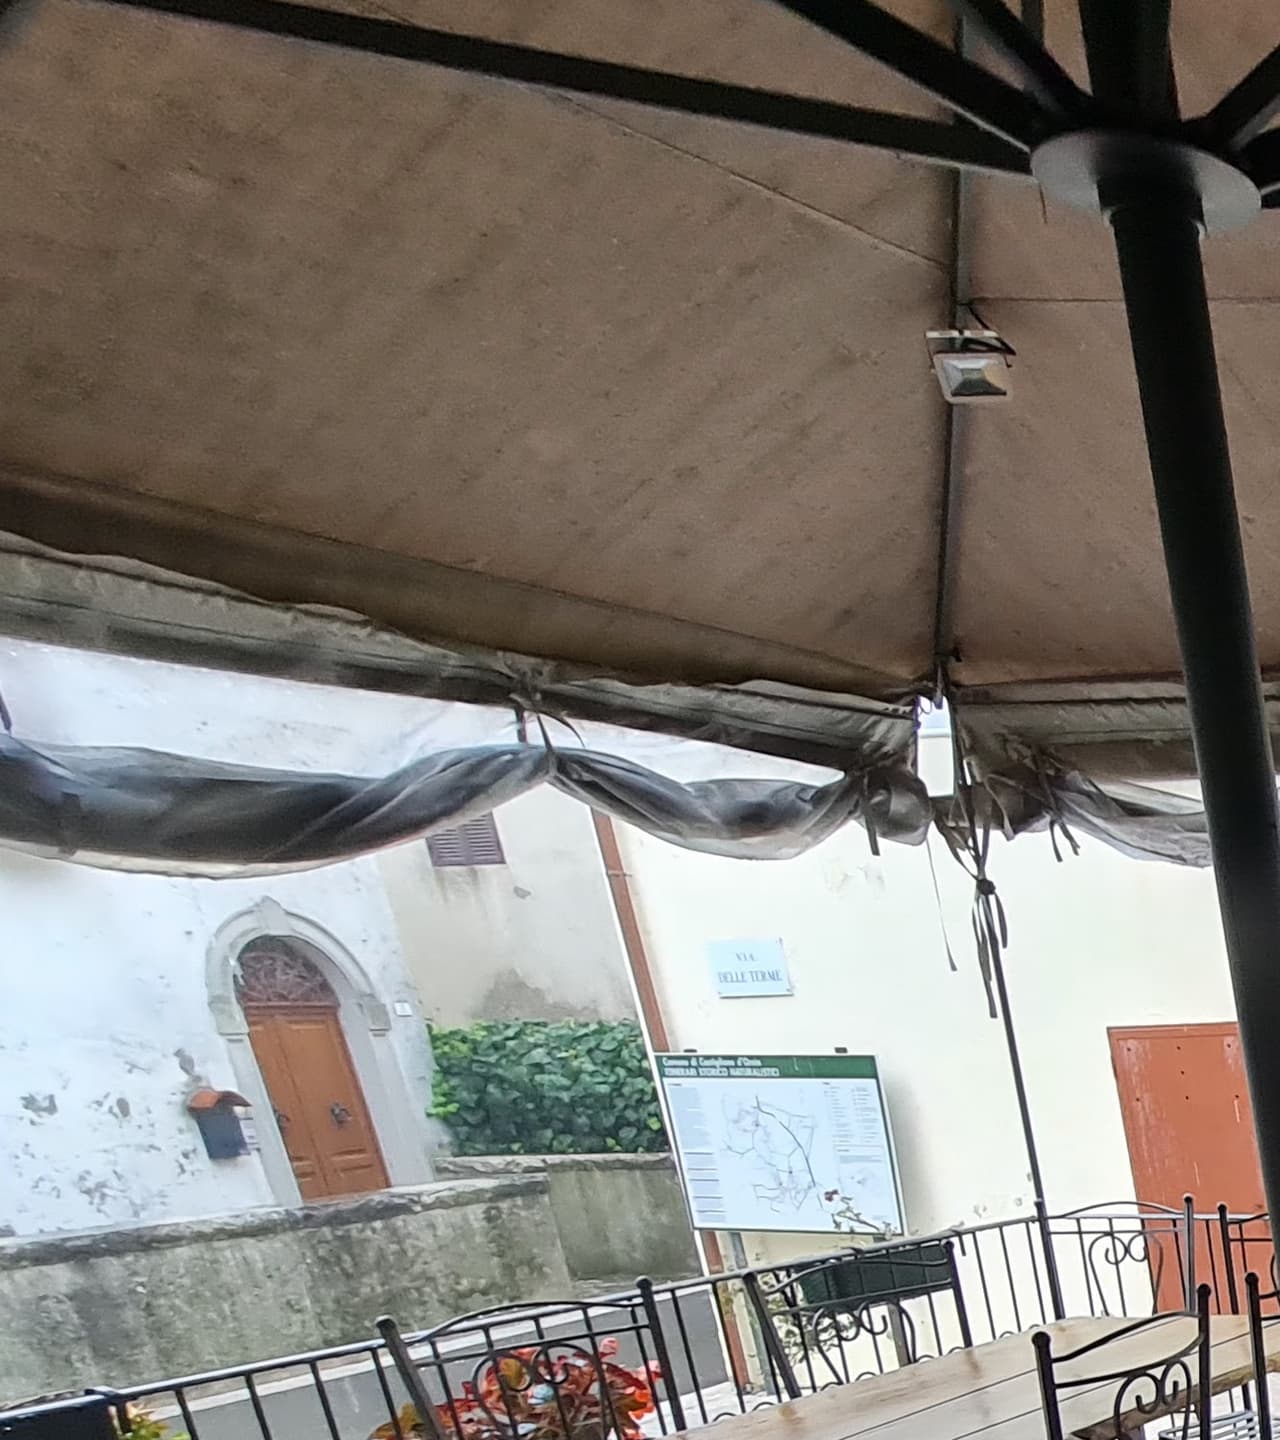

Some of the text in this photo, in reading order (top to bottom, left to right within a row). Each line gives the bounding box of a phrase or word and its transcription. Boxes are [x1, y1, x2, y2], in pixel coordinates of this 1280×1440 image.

[735, 951, 758, 962] VIA
[718, 968, 783, 983] DELLE TERME
